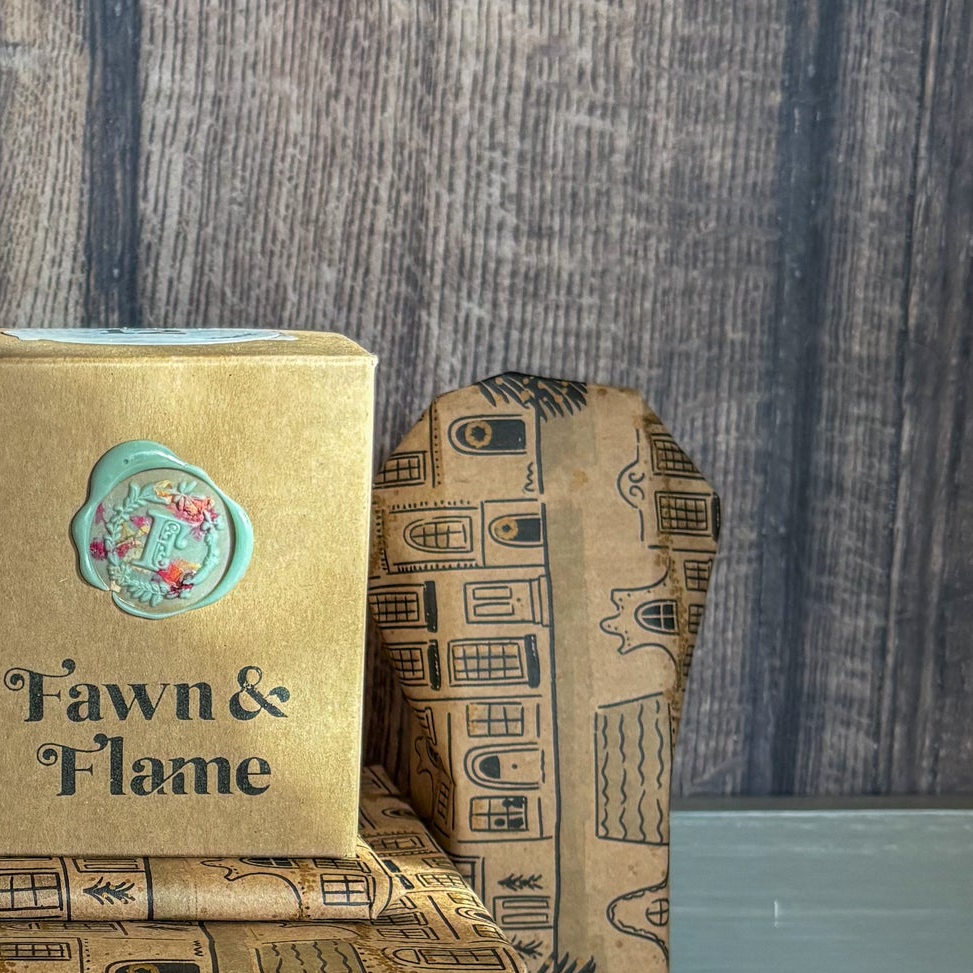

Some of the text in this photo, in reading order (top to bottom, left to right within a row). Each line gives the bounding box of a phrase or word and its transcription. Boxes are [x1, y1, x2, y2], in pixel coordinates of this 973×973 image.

[3, 658, 290, 723] Fawn &
[36, 732, 272, 796] Flame
